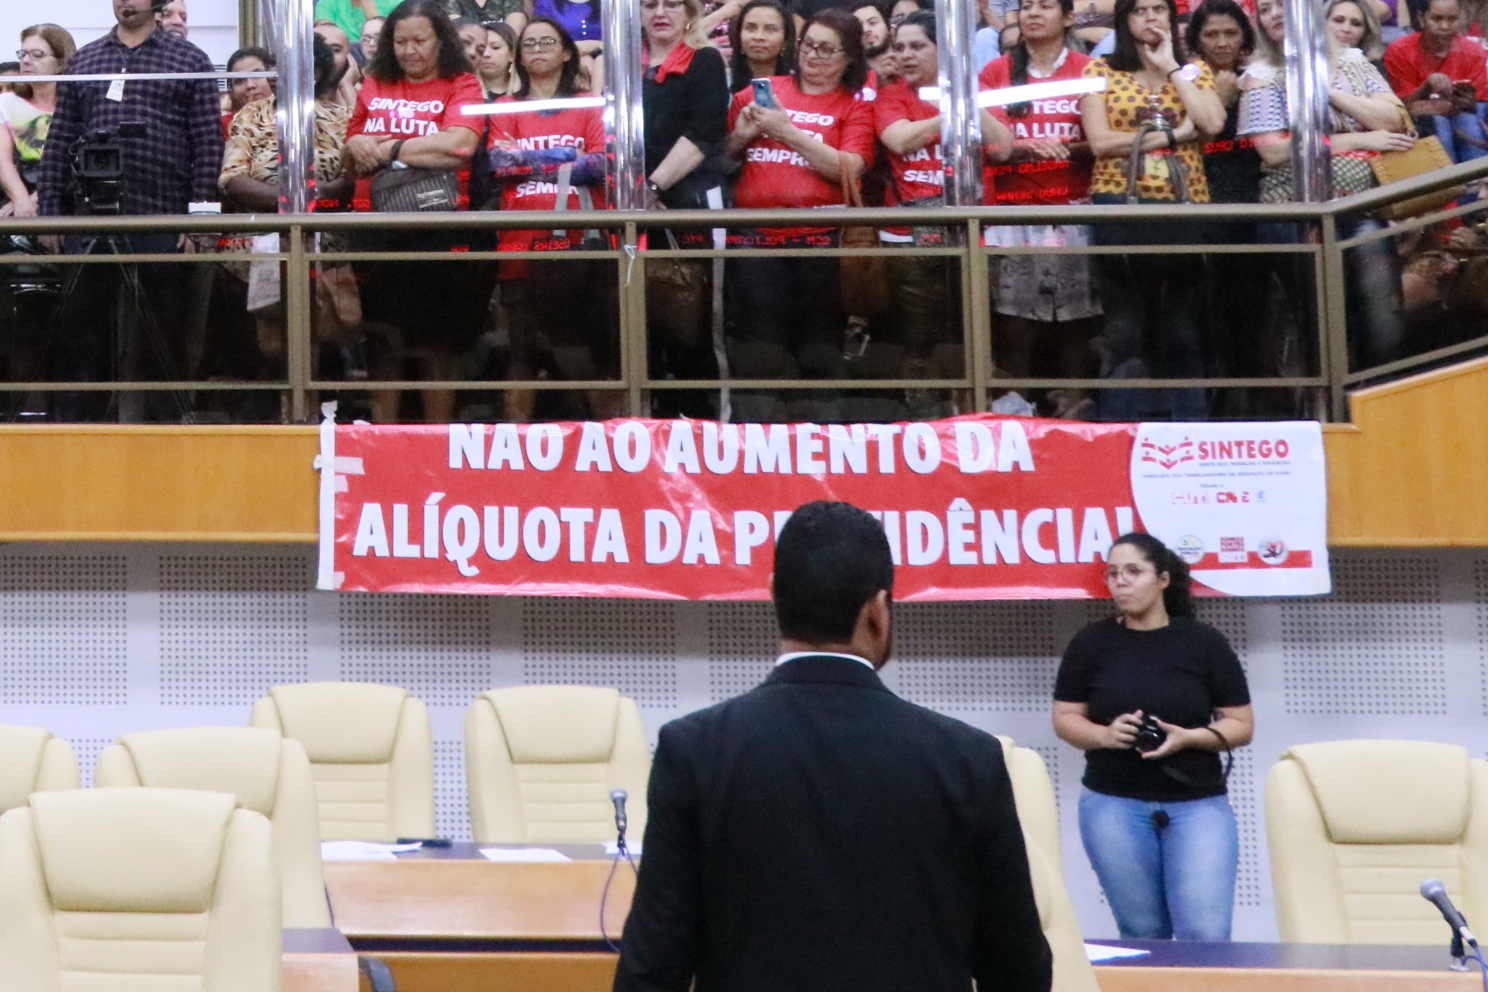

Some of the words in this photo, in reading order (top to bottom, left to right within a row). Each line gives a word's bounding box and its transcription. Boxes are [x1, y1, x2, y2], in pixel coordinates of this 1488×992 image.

[368, 96, 444, 114] SINTEGO
[364, 117, 386, 133] NA
[389, 117, 440, 137] LUTA
[746, 147, 810, 167] SEMPR
[574, 420, 652, 473] AO
[664, 420, 941, 475] AUMENTO
[953, 419, 1036, 474] DA
[1198, 439, 1290, 460] SINTEGO
[352, 492, 630, 577] ALÍQUOTA
[643, 509, 721, 566] DA
